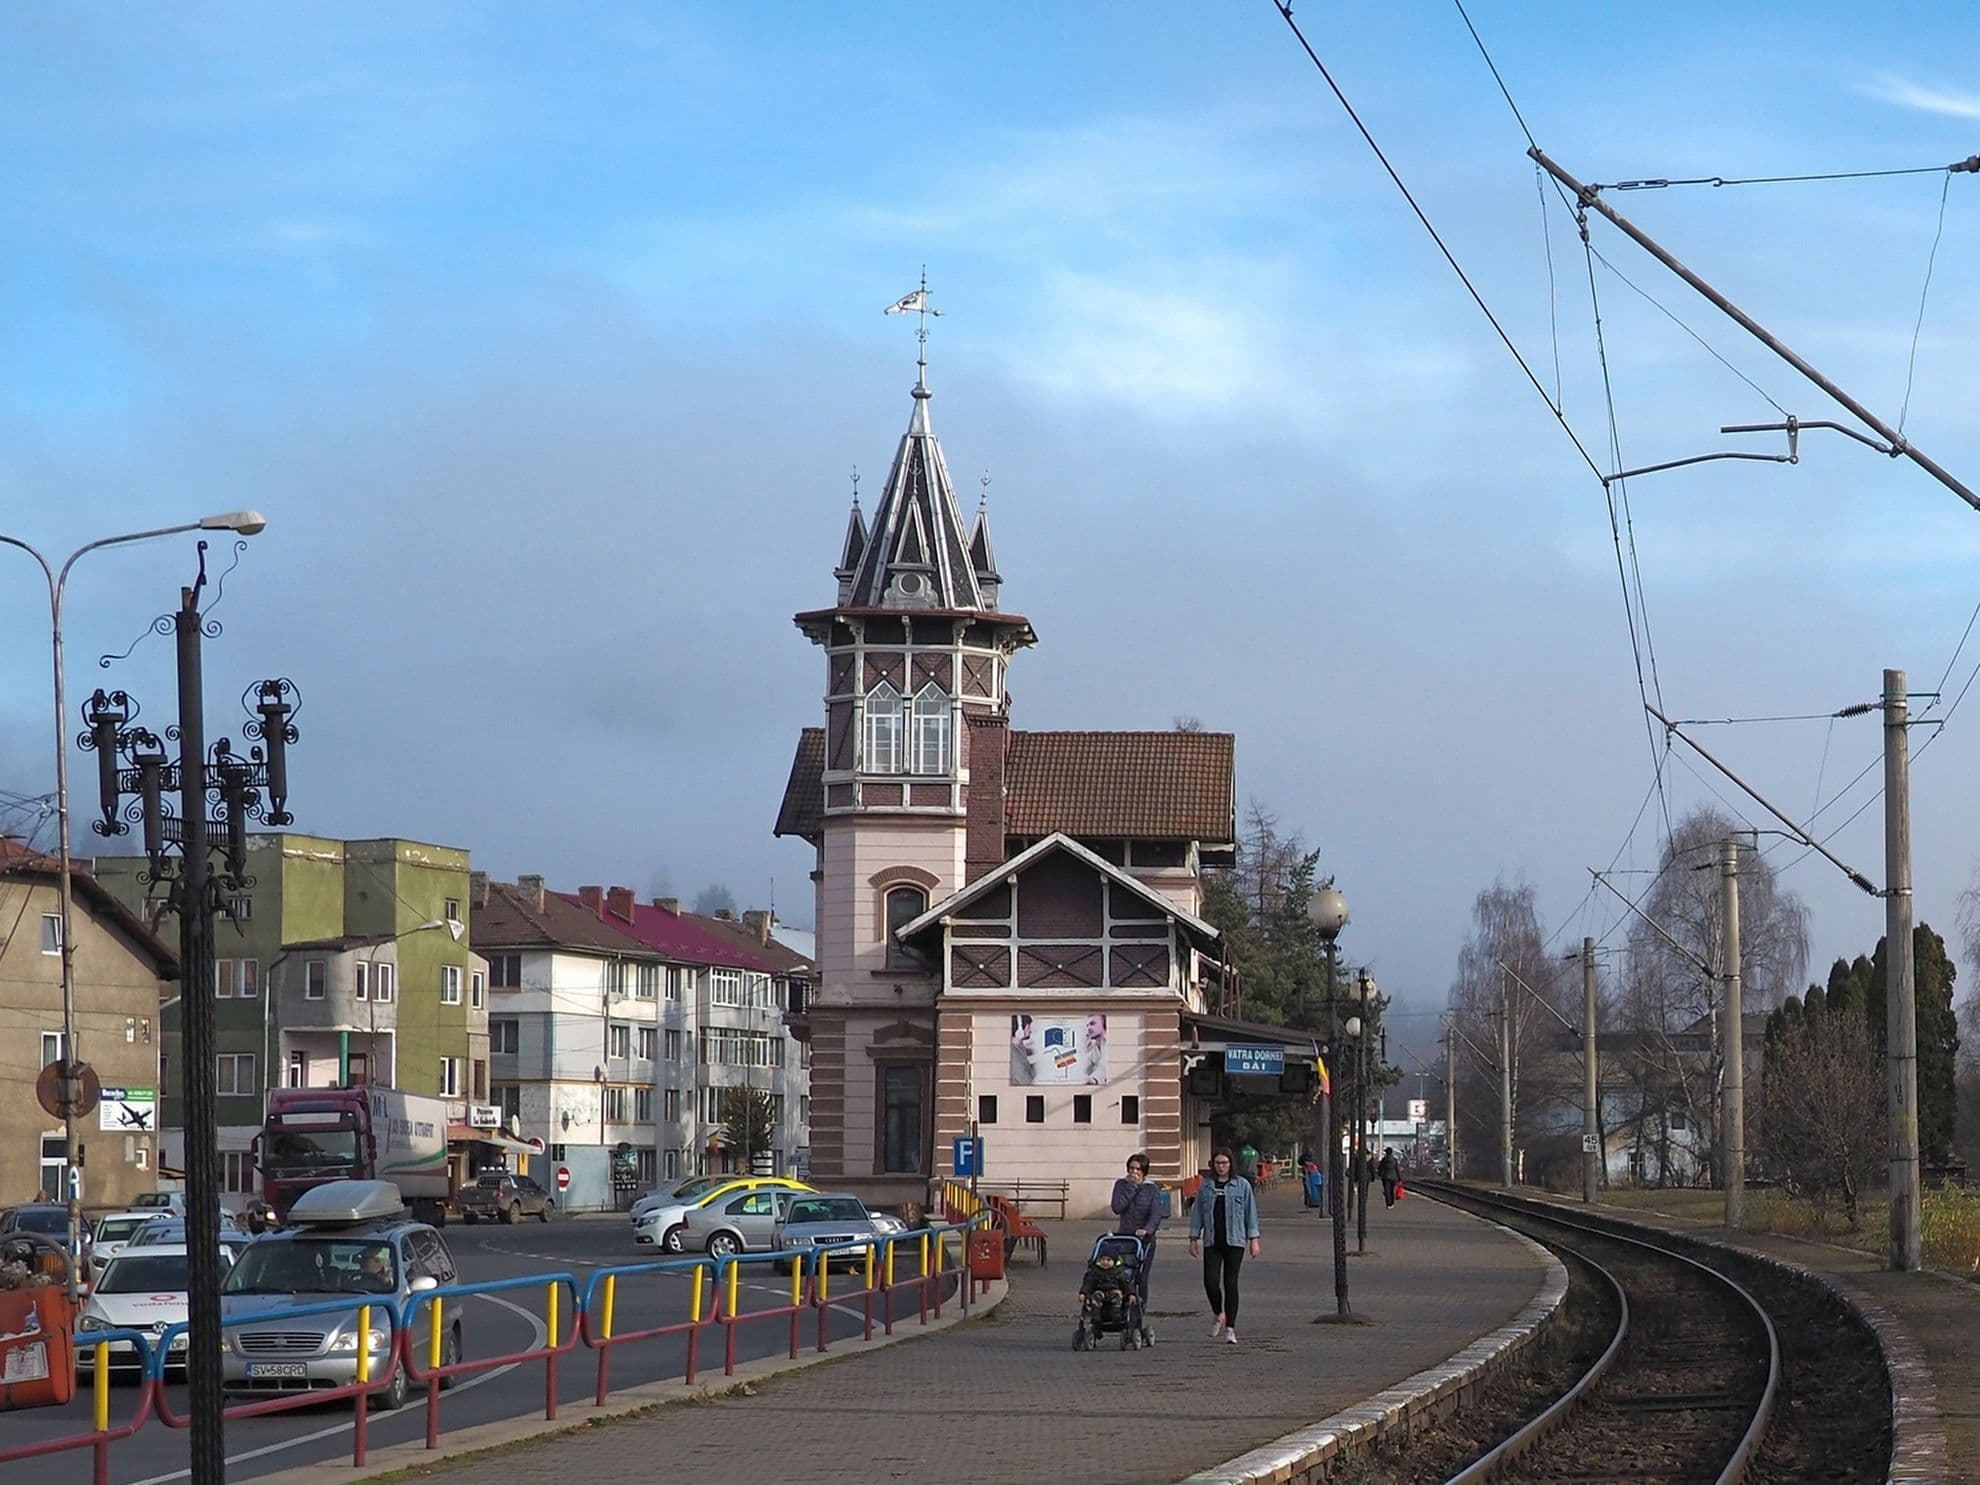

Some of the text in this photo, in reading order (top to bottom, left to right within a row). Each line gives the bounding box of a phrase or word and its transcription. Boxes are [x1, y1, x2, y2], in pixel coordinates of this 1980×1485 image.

[1227, 1049, 1253, 1060] VATRA
[1584, 1135, 1598, 1144] 45
[959, 1141, 973, 1165] P
